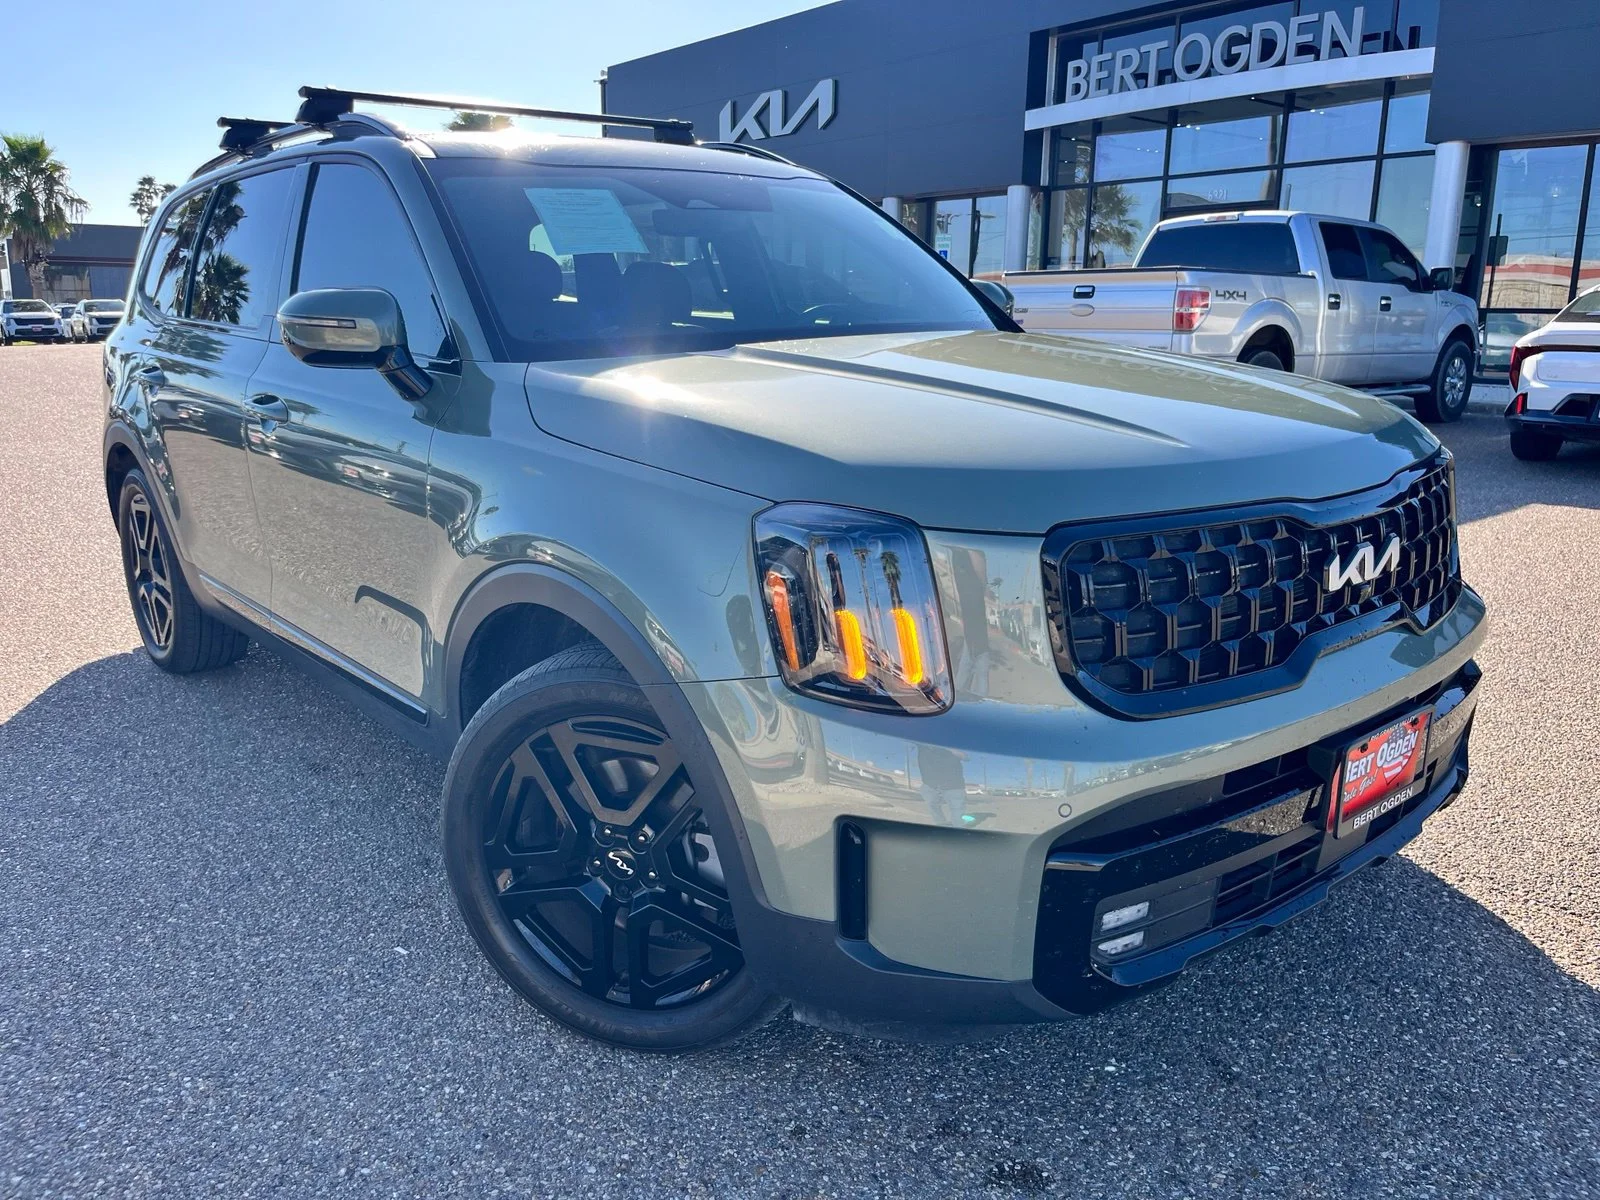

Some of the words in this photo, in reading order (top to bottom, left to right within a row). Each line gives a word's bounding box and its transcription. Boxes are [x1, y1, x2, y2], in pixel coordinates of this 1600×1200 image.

[1065, 40, 1168, 103] BERT
[1174, 6, 1364, 82] OGDEN
[719, 78, 837, 143] KIA
[1325, 532, 1401, 593] KIA
[1353, 805, 1380, 830] BERT
[1380, 786, 1414, 814] OGDEN
